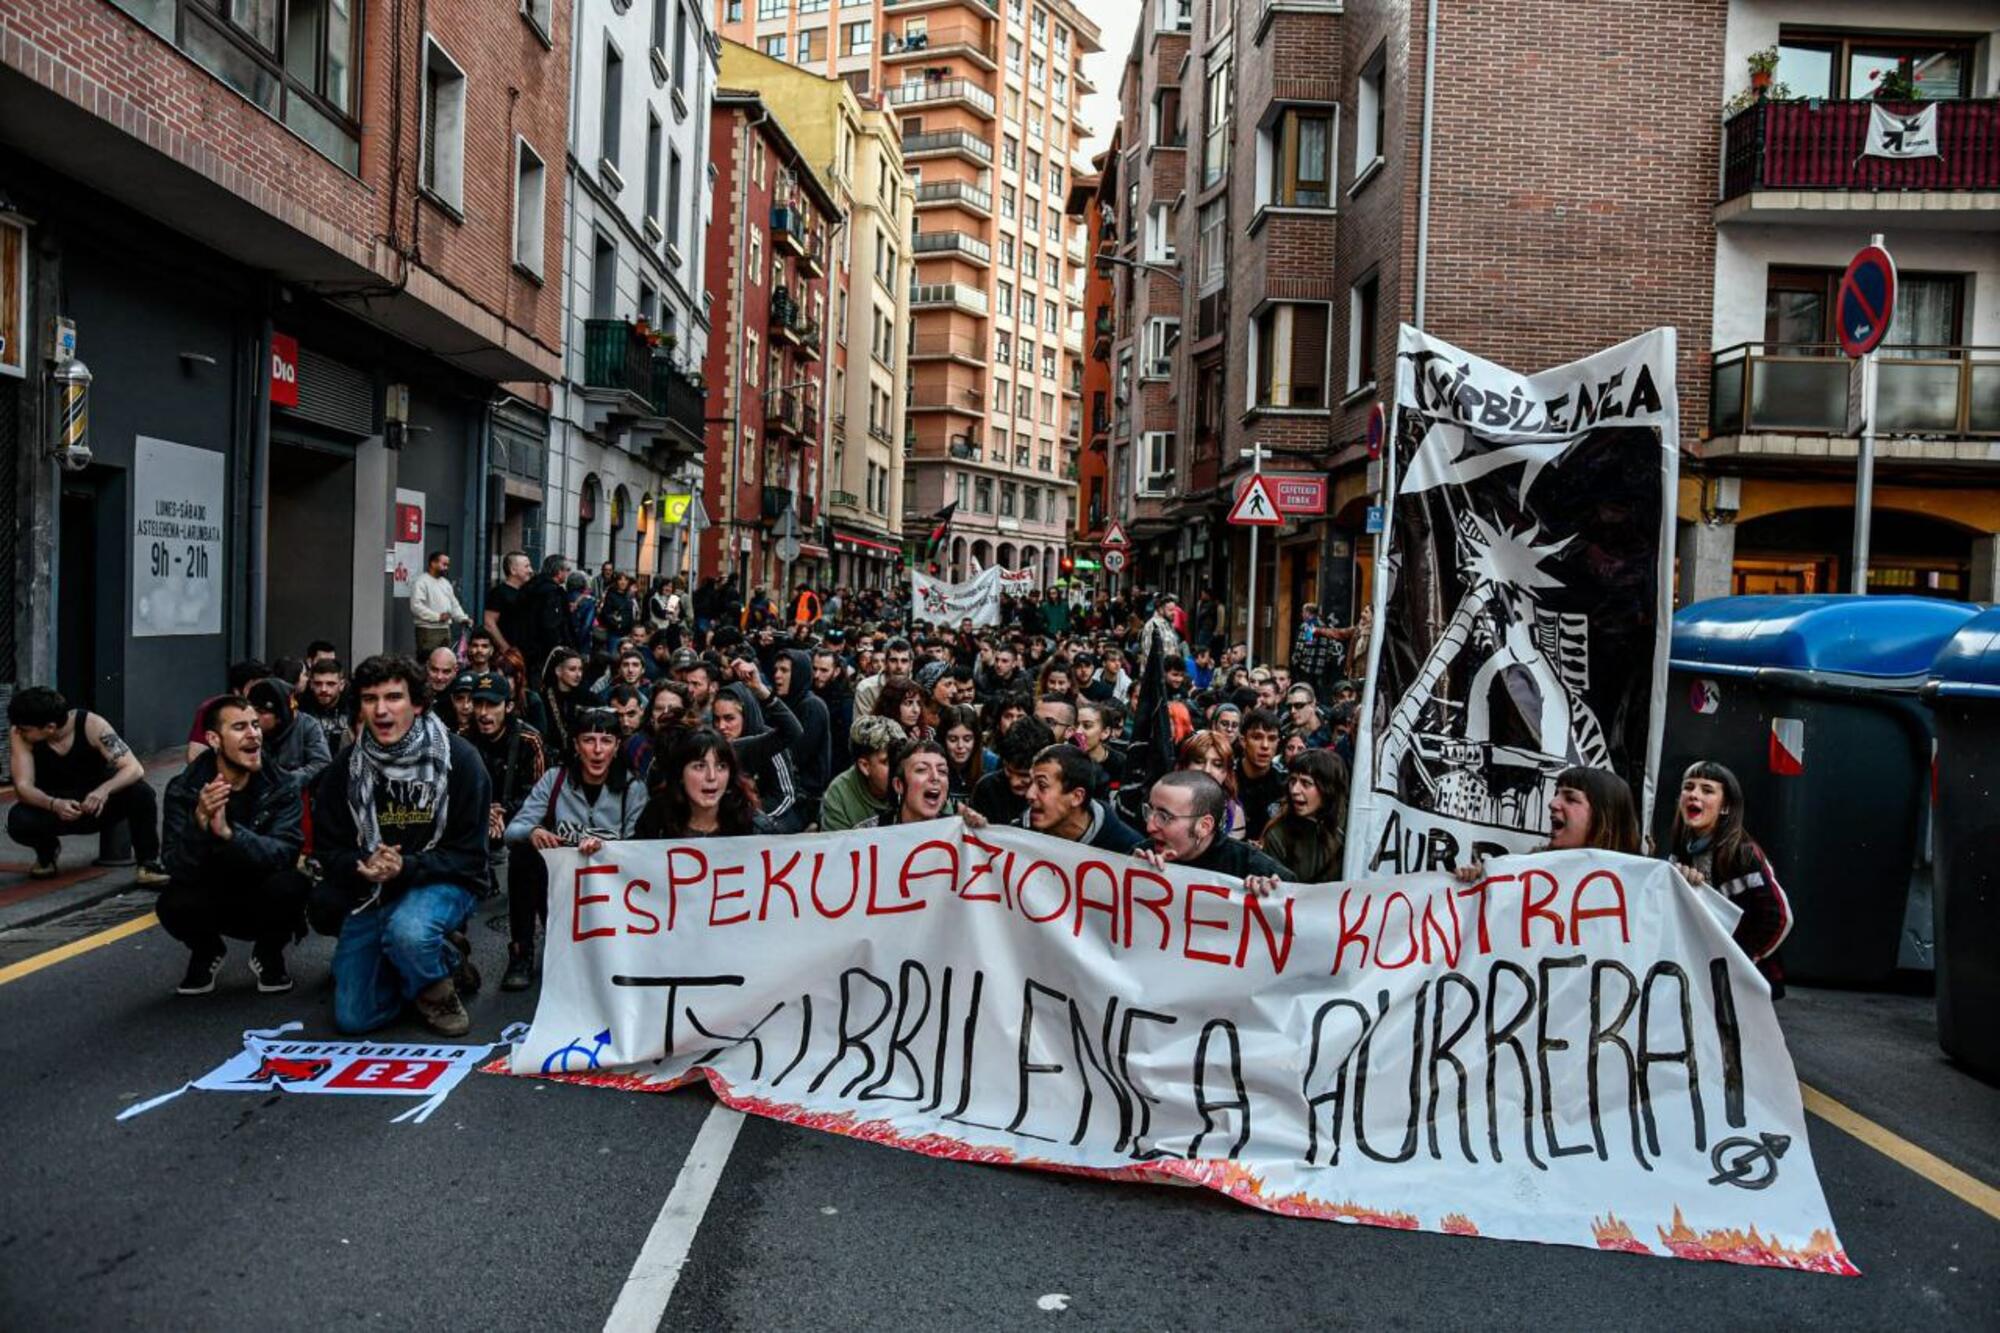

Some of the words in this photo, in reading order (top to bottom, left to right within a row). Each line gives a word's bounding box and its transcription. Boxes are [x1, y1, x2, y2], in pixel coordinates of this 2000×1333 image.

[1398, 350, 1662, 434] TXIRBILENEA
[151, 541, 169, 577] 9h
[186, 543, 208, 578] 21h
[1107, 555, 1123, 566] 30
[571, 839, 1295, 975] ESPEKULAZIOAREN
[1330, 869, 1630, 976] KONTRA
[262, 1044, 466, 1058] SUBFLUBIALA
[611, 959, 1251, 1160] TXIRBILENEA
[1303, 954, 1747, 1172] AURRERA!
[354, 1063, 422, 1082] EZ
